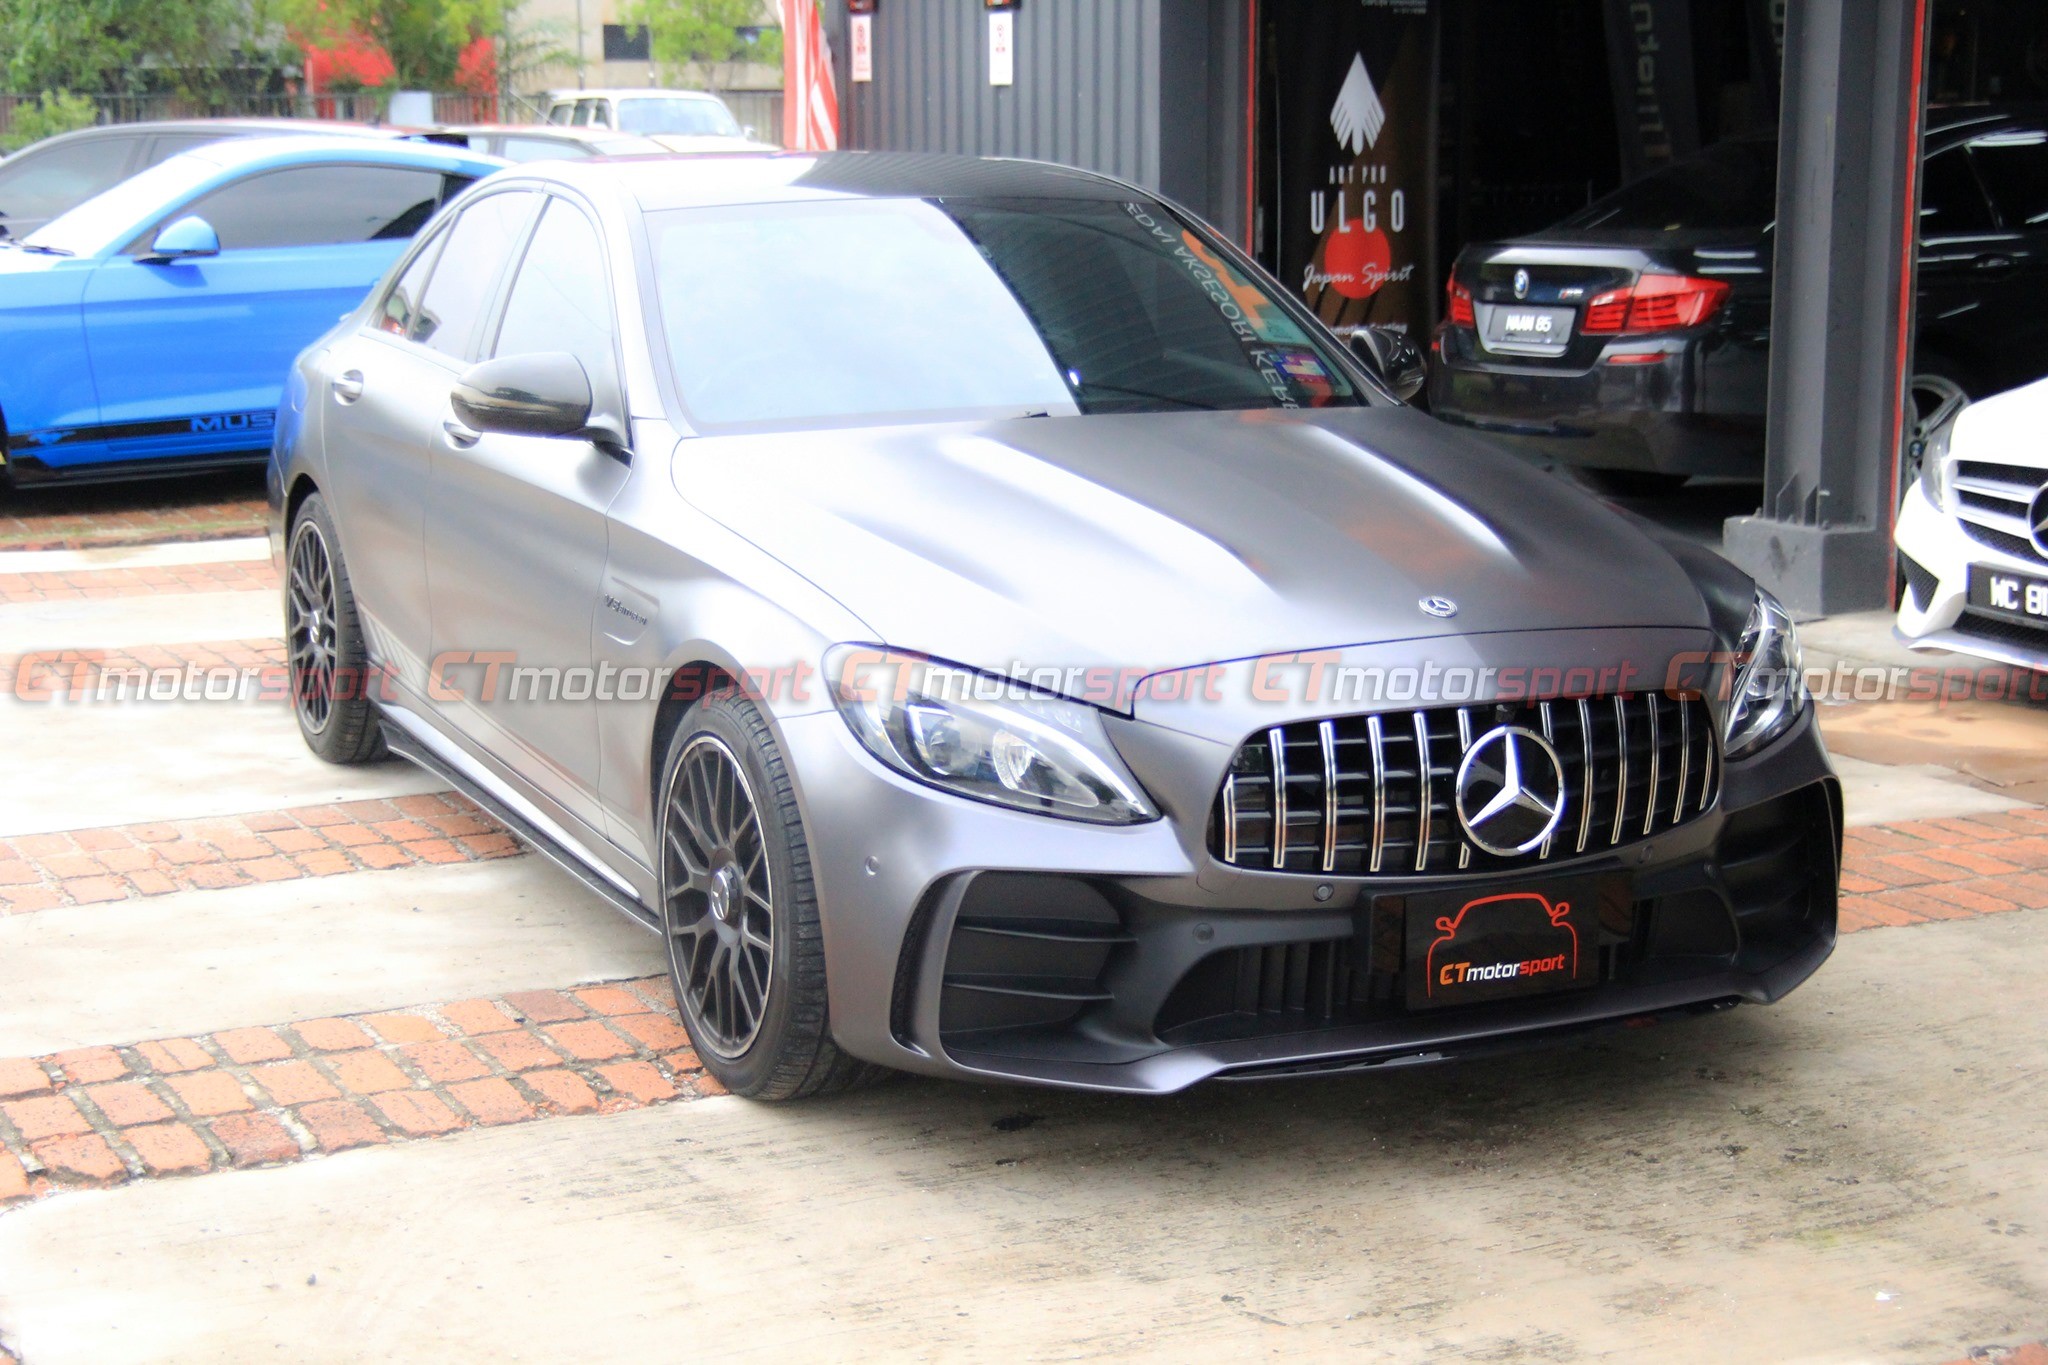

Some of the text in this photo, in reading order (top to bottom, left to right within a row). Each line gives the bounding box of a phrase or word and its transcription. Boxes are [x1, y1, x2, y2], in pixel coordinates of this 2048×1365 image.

[1310, 189, 1405, 235] ULGO
[1302, 263, 1415, 293] Japan Spirit
[1990, 576, 2019, 610] WC
[1439, 953, 1566, 986] CTmotorsport
